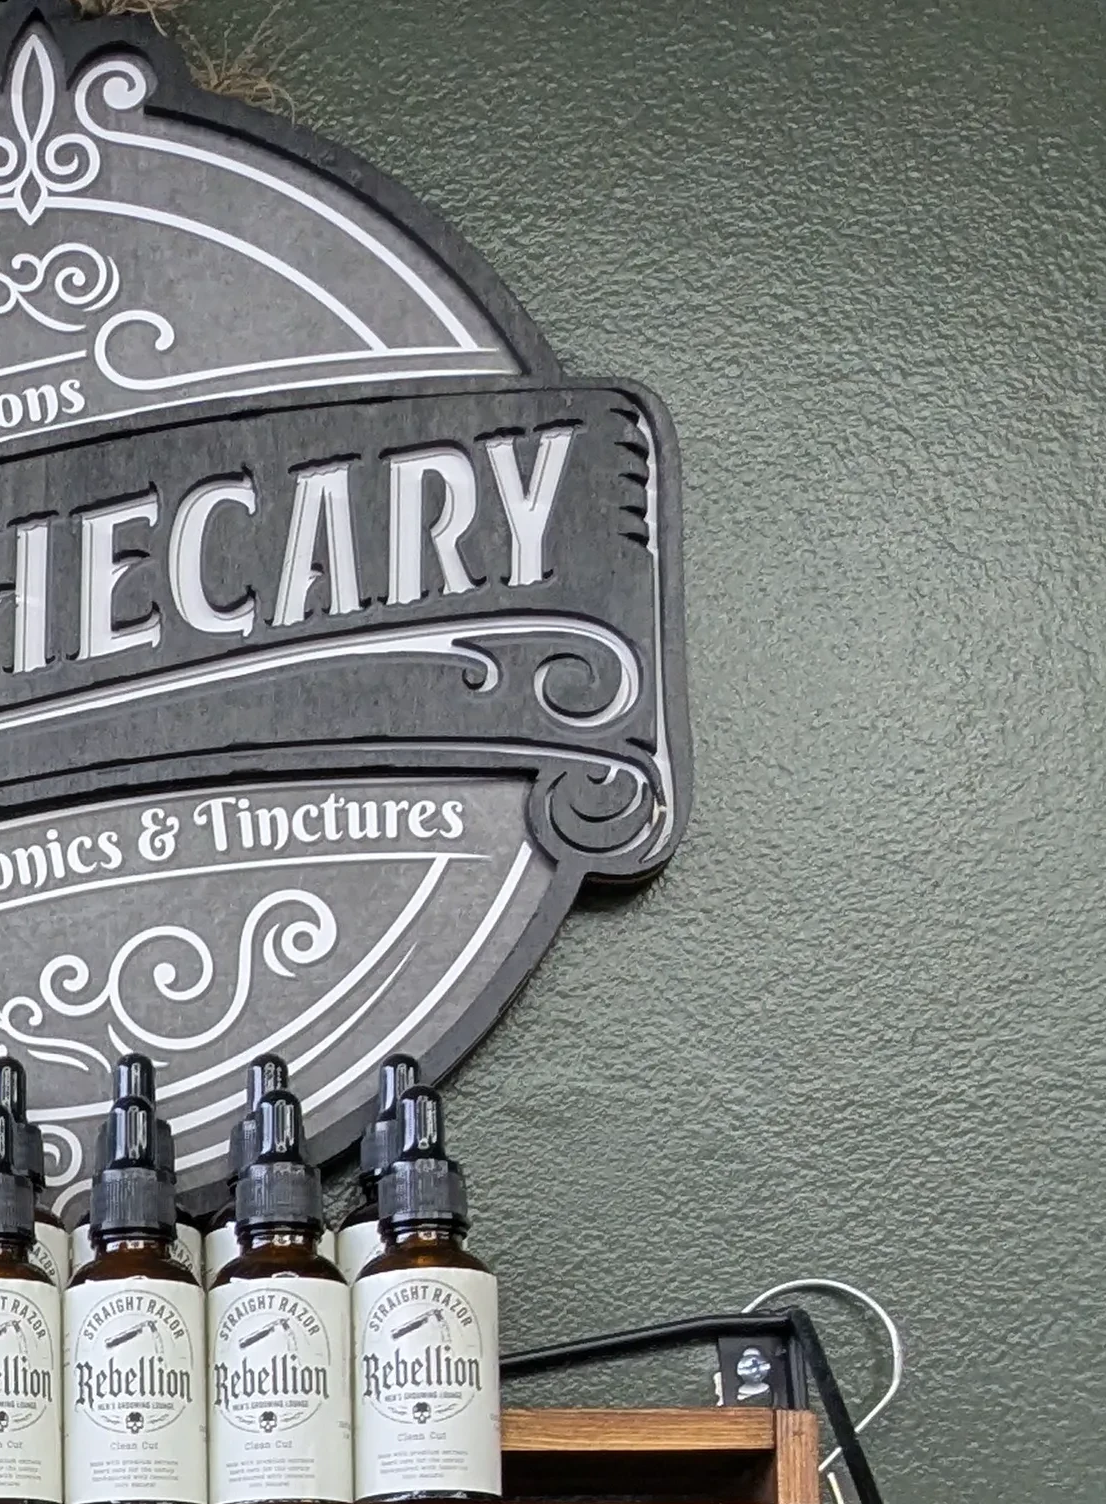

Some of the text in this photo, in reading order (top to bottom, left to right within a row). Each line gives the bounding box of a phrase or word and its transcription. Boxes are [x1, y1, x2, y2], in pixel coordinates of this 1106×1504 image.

[139, 809, 179, 861] &
[194, 793, 465, 851] Tinctures
[11, 1298, 45, 1340] RAZOR
[84, 1297, 185, 1340] STRAIGHT RAZOR
[219, 1295, 321, 1342] STRAIGHT RAZOR
[369, 1286, 474, 1332] STRAIGHT RAZOR
[75, 1356, 192, 1412] Rebellion
[214, 1354, 329, 1411] Rebellion
[364, 1345, 482, 1401] Rebellion
[245, 1441, 270, 1450] Clean
[398, 1431, 446, 1441] Clean Cut
